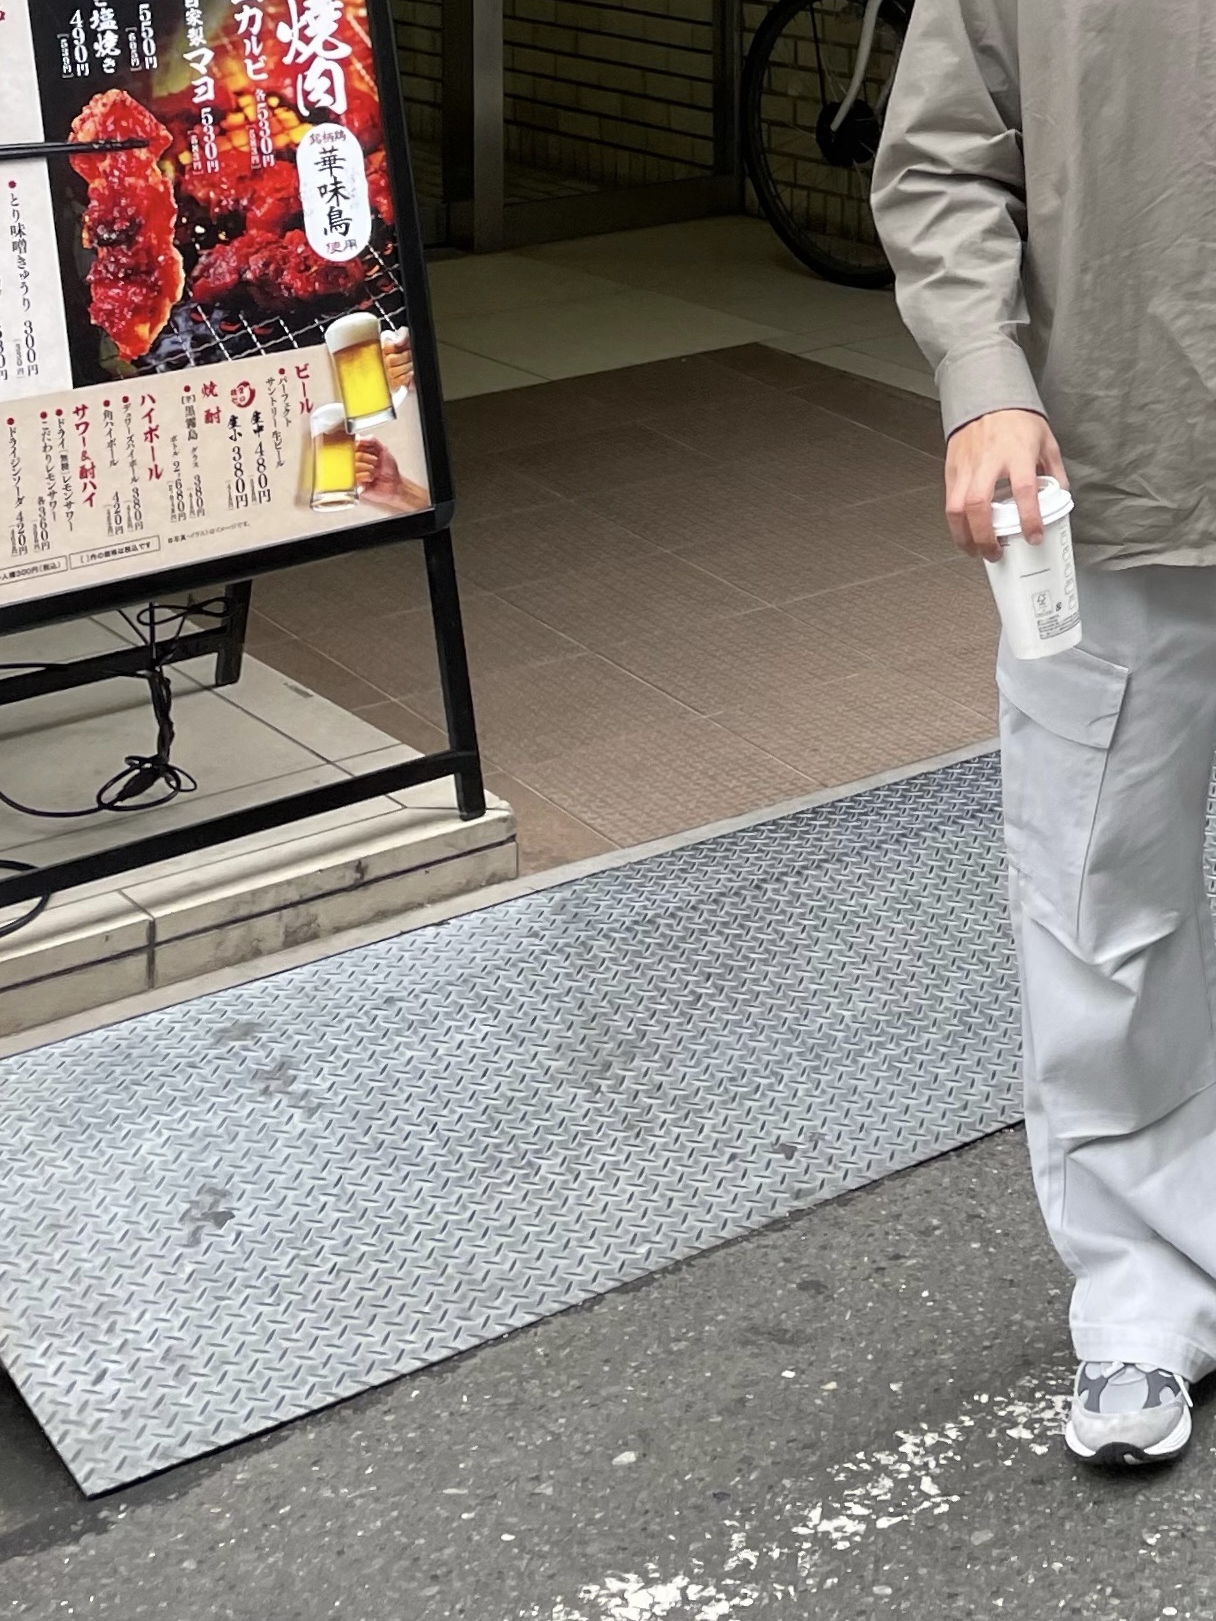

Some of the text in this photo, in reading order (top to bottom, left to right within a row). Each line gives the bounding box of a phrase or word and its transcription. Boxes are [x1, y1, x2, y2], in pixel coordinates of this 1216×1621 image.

[69, 9, 90, 77] 490円
[138, 3, 158, 70] 550円
[201, 107, 219, 174] 530円
[313, 145, 352, 237] 華味鳥
[325, 238, 358, 254] 使用
[10, 192, 39, 377] とり味噌きゅうり 300円
[201, 380, 221, 425] 焼酎
[295, 363, 314, 415] ビール
[9, 427, 25, 509] ドライジンソーダ
[41, 421, 58, 522] こだわりレモンサワー
[72, 404, 98, 508] サワー&酎ハイ
[140, 394, 164, 482] ハイボール
[103, 409, 124, 535] 角ハイボール 420円
[232, 445, 249, 509] 380円
[255, 441, 271, 504] 480円
[15, 511, 28, 556] 420円
[132, 486, 144, 531] 380円
